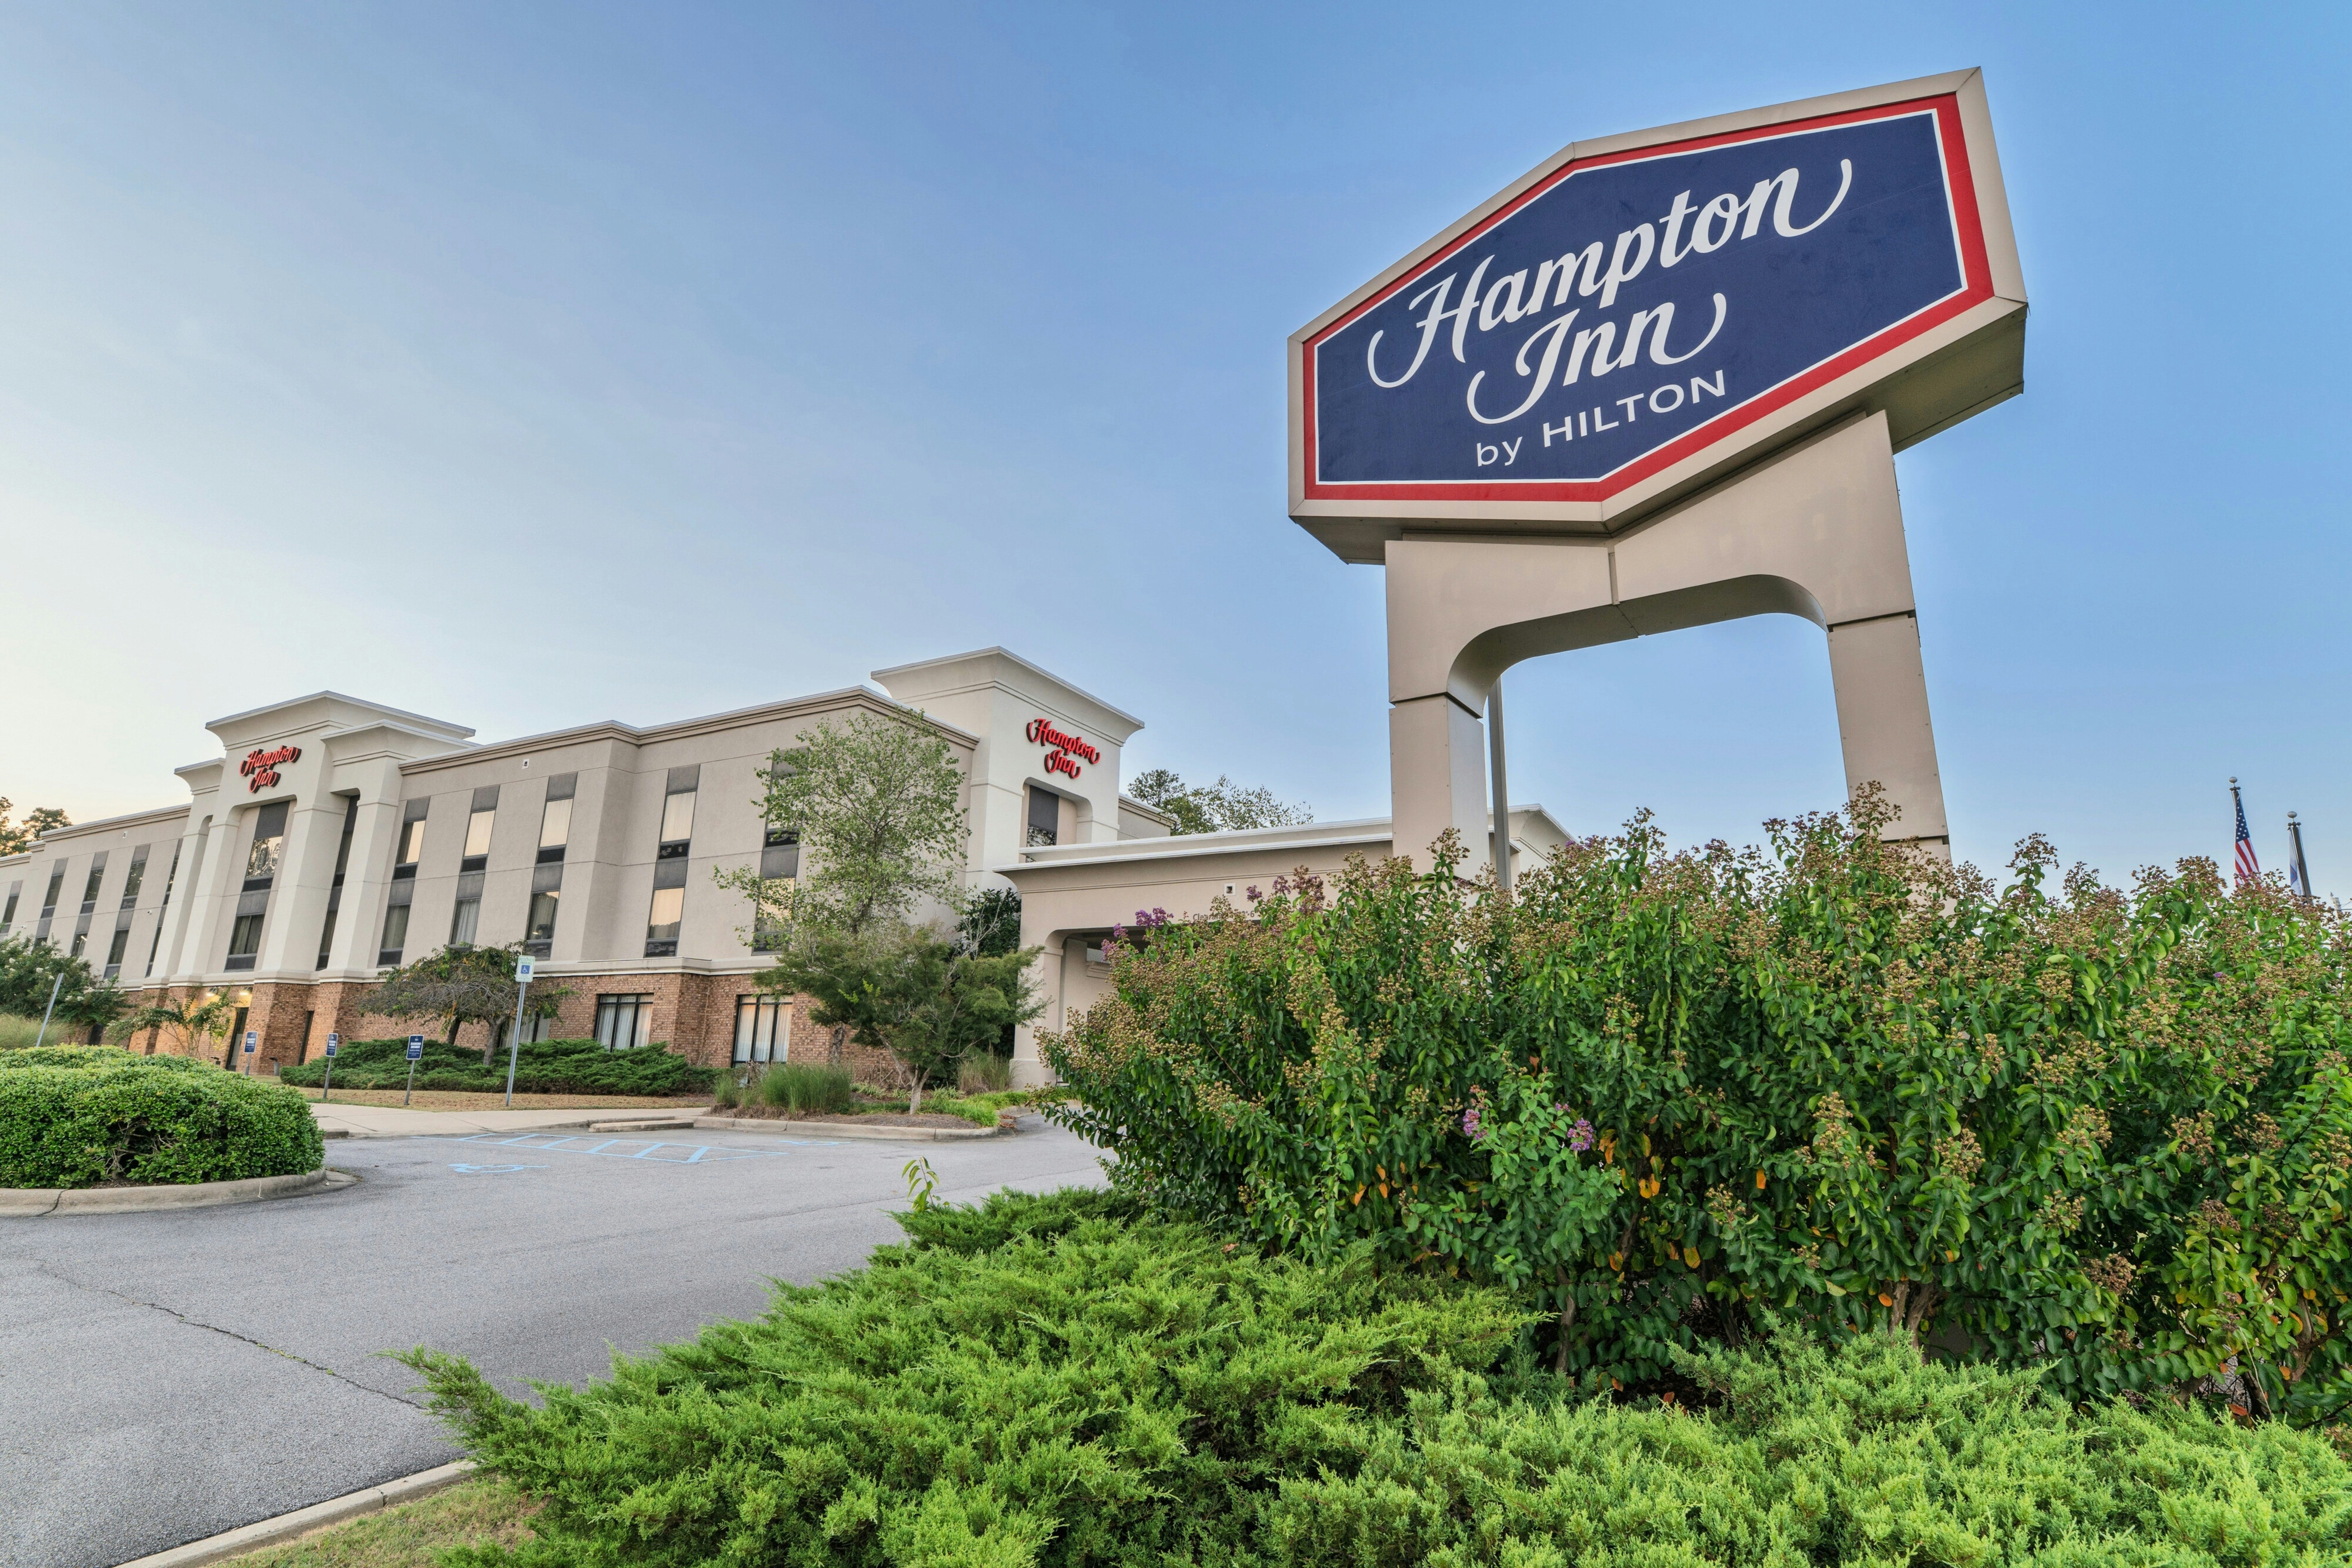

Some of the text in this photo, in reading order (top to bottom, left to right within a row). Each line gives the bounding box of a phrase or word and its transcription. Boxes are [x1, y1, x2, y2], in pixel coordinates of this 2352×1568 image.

[1367, 158, 1853, 388] Hampton
[1466, 292, 1727, 425] Inn
[1476, 369, 1726, 467] by HILTON
[239, 745, 301, 776] Hampton
[1026, 717, 1101, 764] Hampton
[1044, 749, 1081, 779] Inn
[249, 767, 281, 793] Inn
